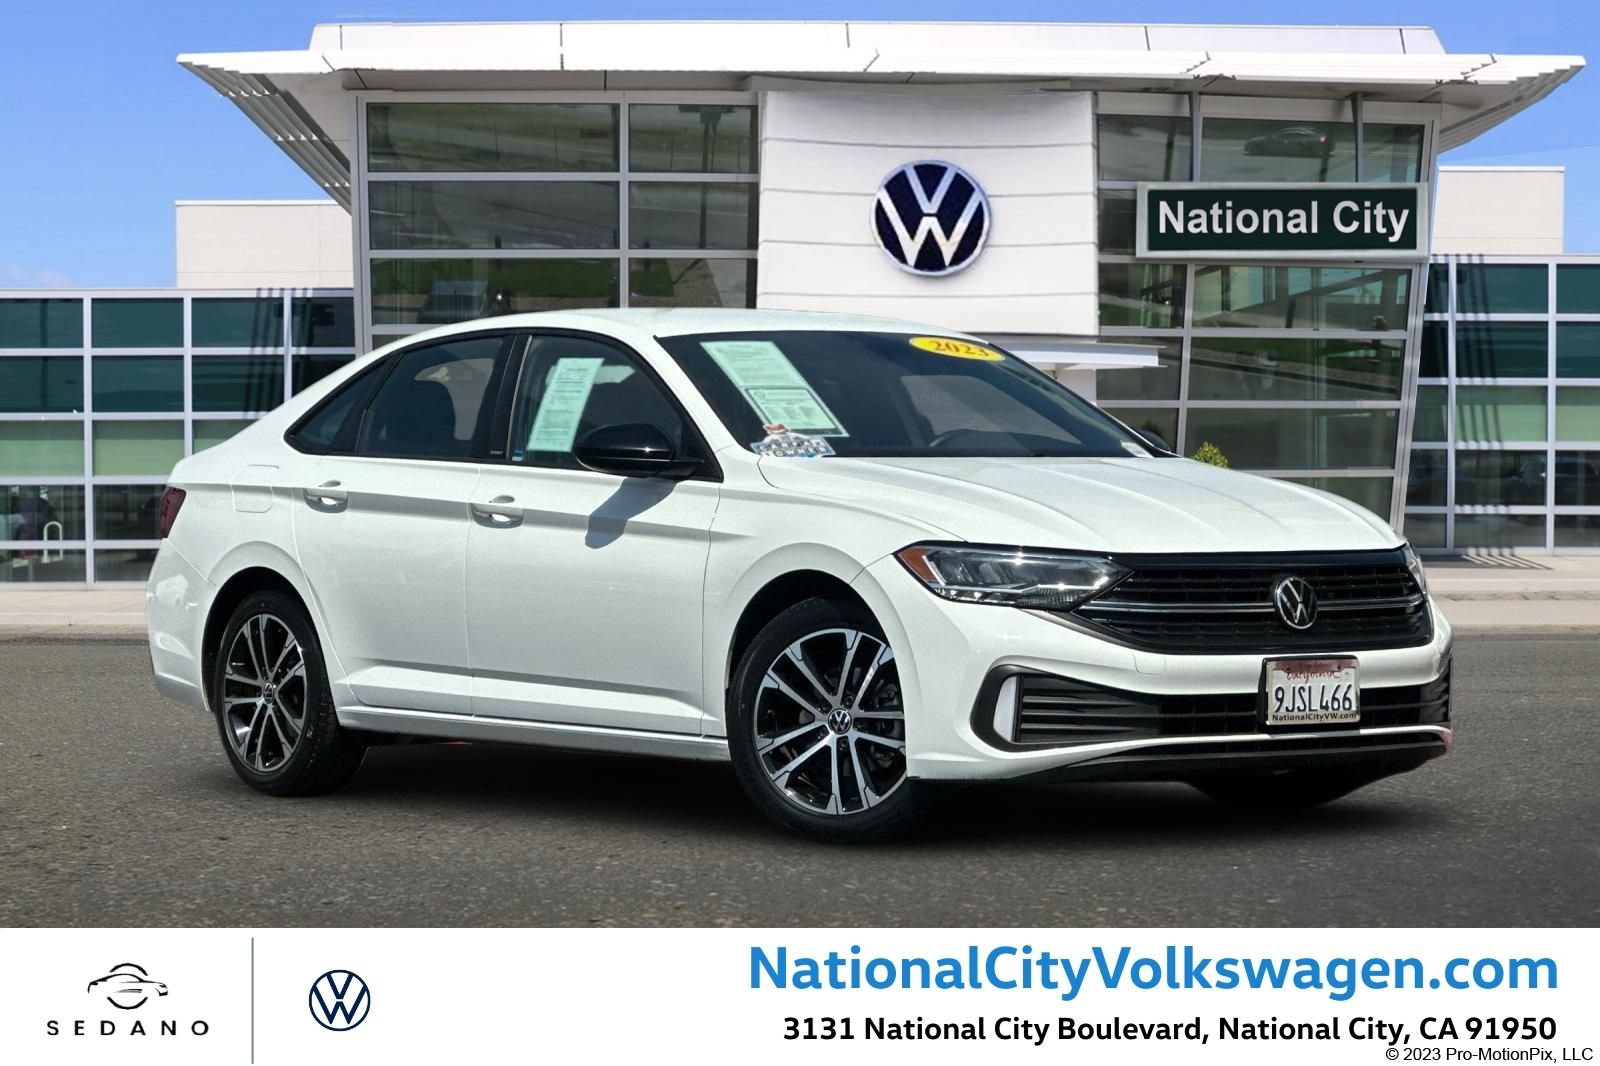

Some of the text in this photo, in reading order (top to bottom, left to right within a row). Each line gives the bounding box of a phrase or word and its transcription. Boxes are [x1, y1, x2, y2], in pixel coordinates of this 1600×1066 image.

[1159, 200, 1410, 243] National City
[928, 341, 989, 357] 2023
[1274, 683, 1353, 713] 9JSL466
[1272, 712, 1357, 722] NationalCityVW.com
